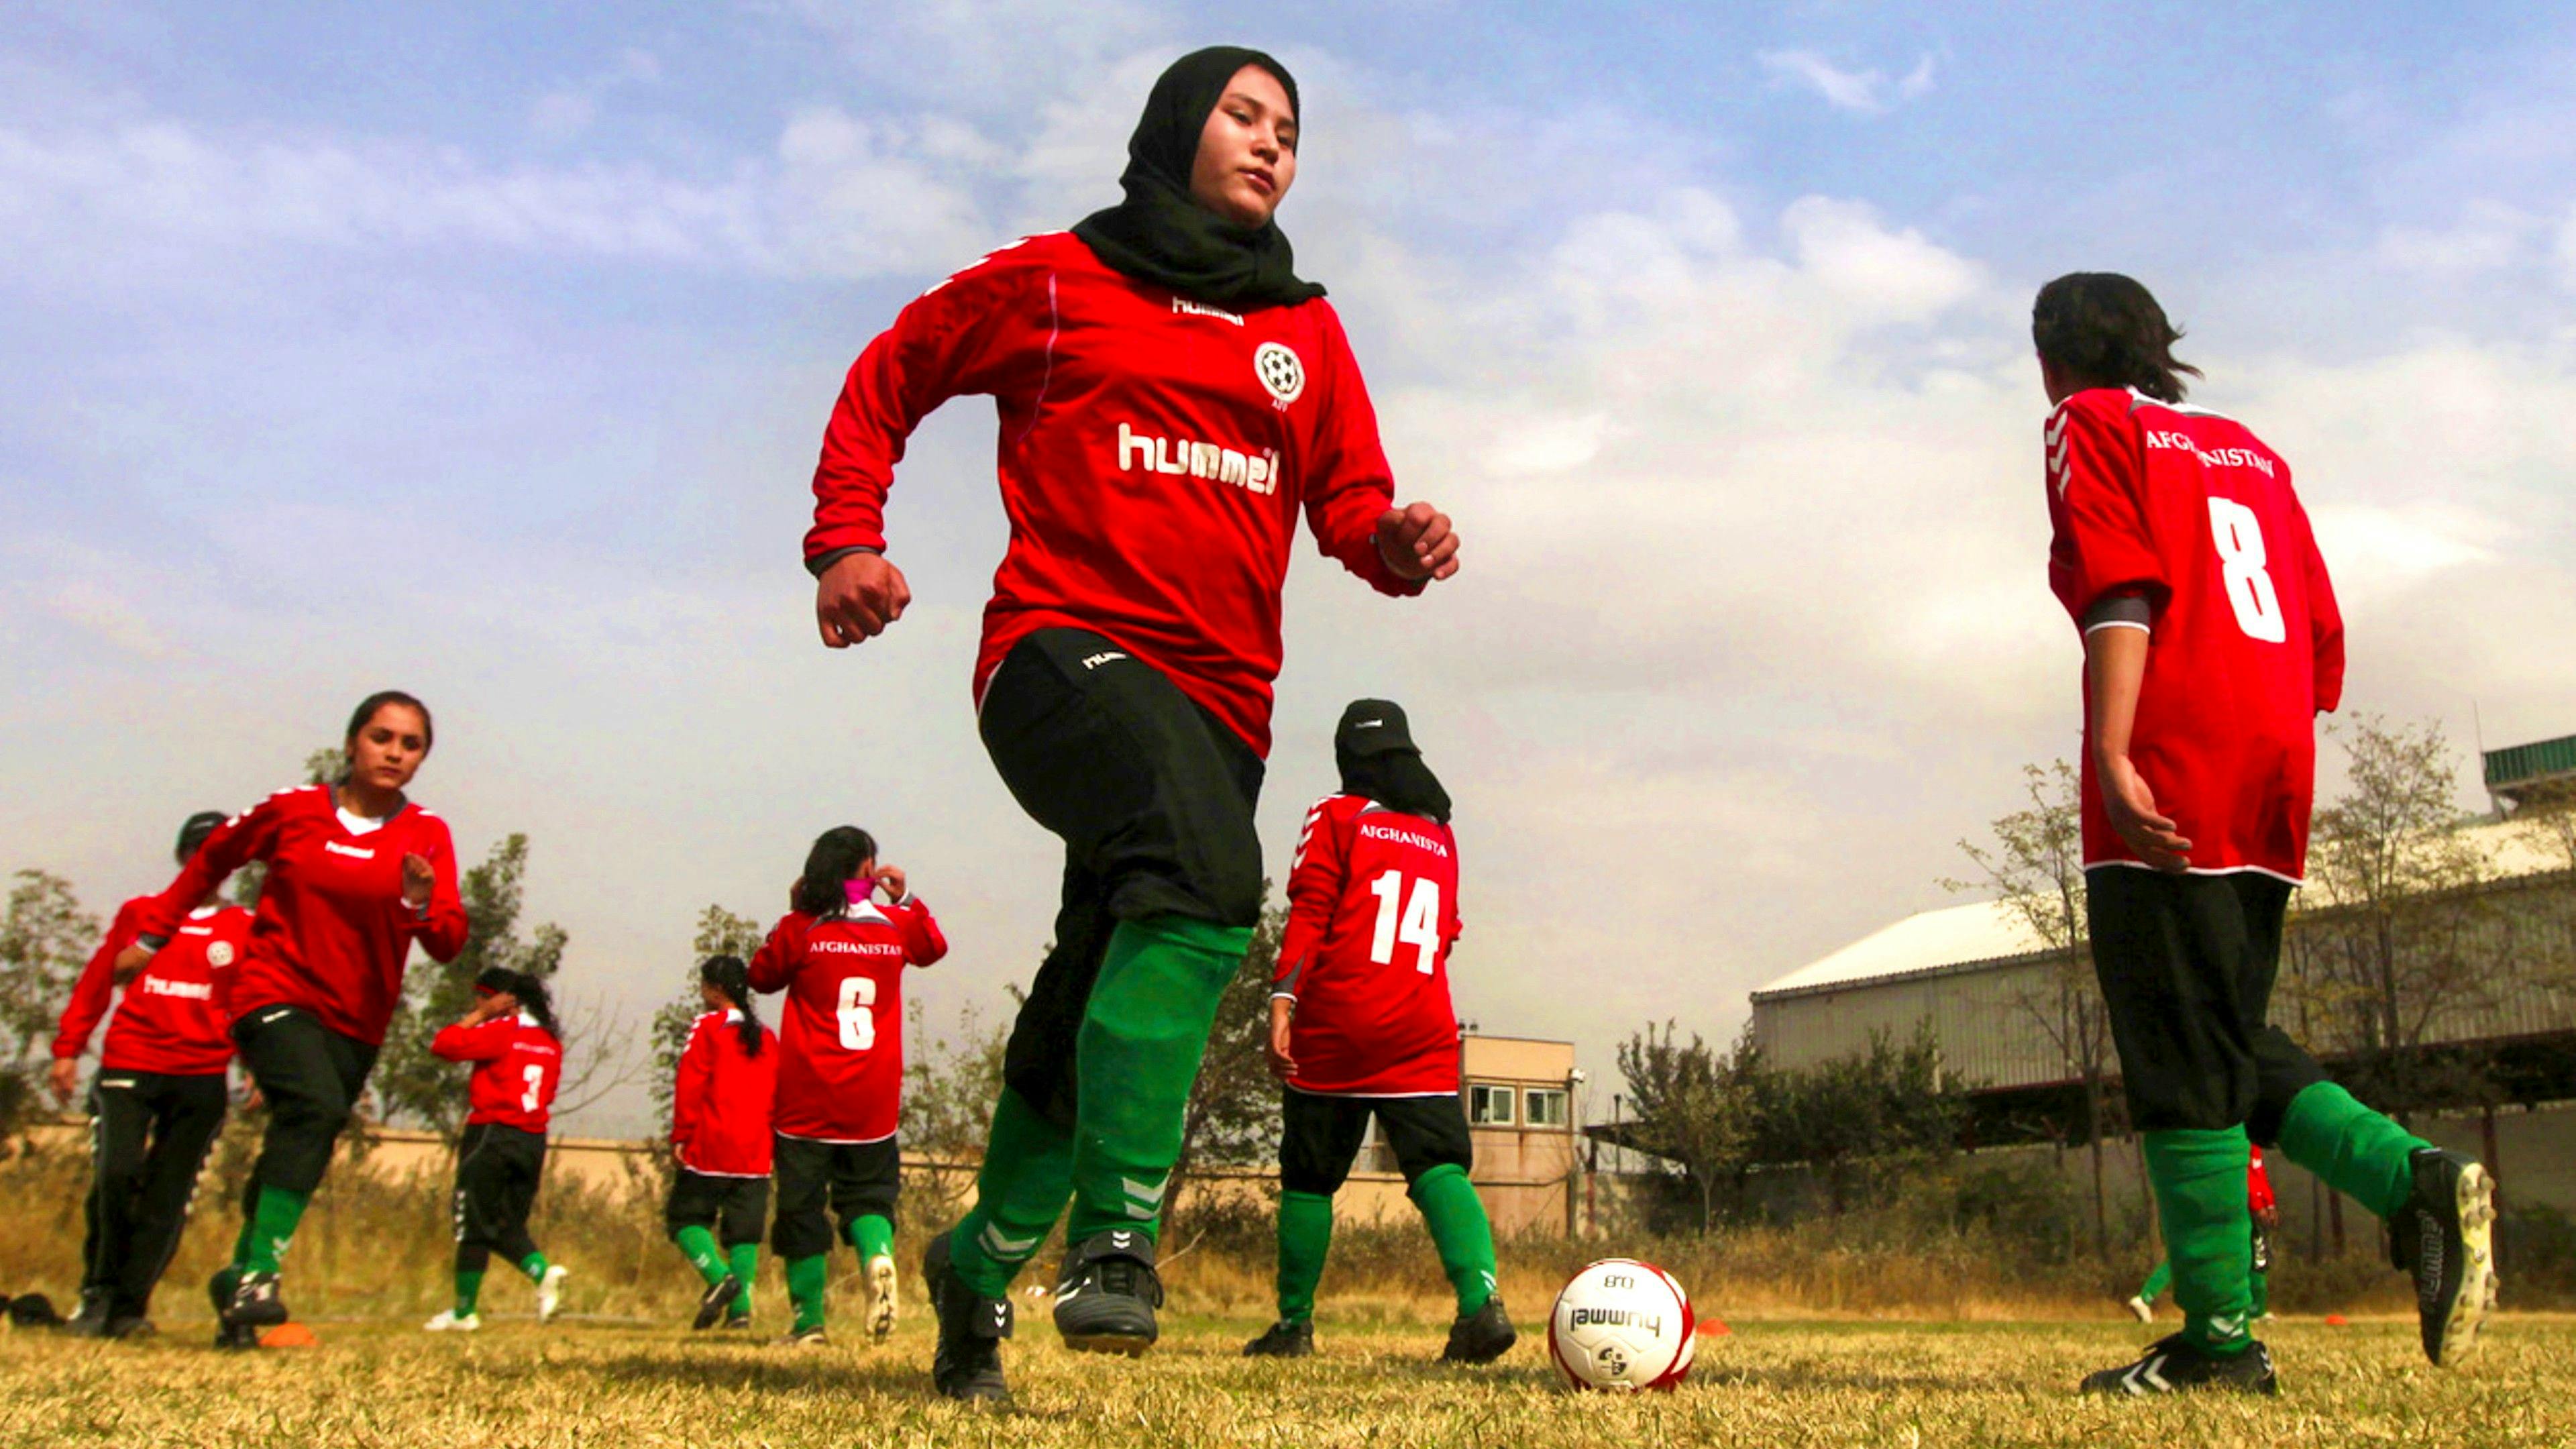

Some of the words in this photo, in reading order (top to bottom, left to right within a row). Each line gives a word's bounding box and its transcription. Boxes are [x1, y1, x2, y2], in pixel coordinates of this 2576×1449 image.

[1118, 422, 1280, 495] hummel
[2207, 496, 2286, 643] 8
[1371, 869, 1440, 975] 14
[837, 976, 877, 1051] 6
[1570, 1308, 1661, 1338] hummel
